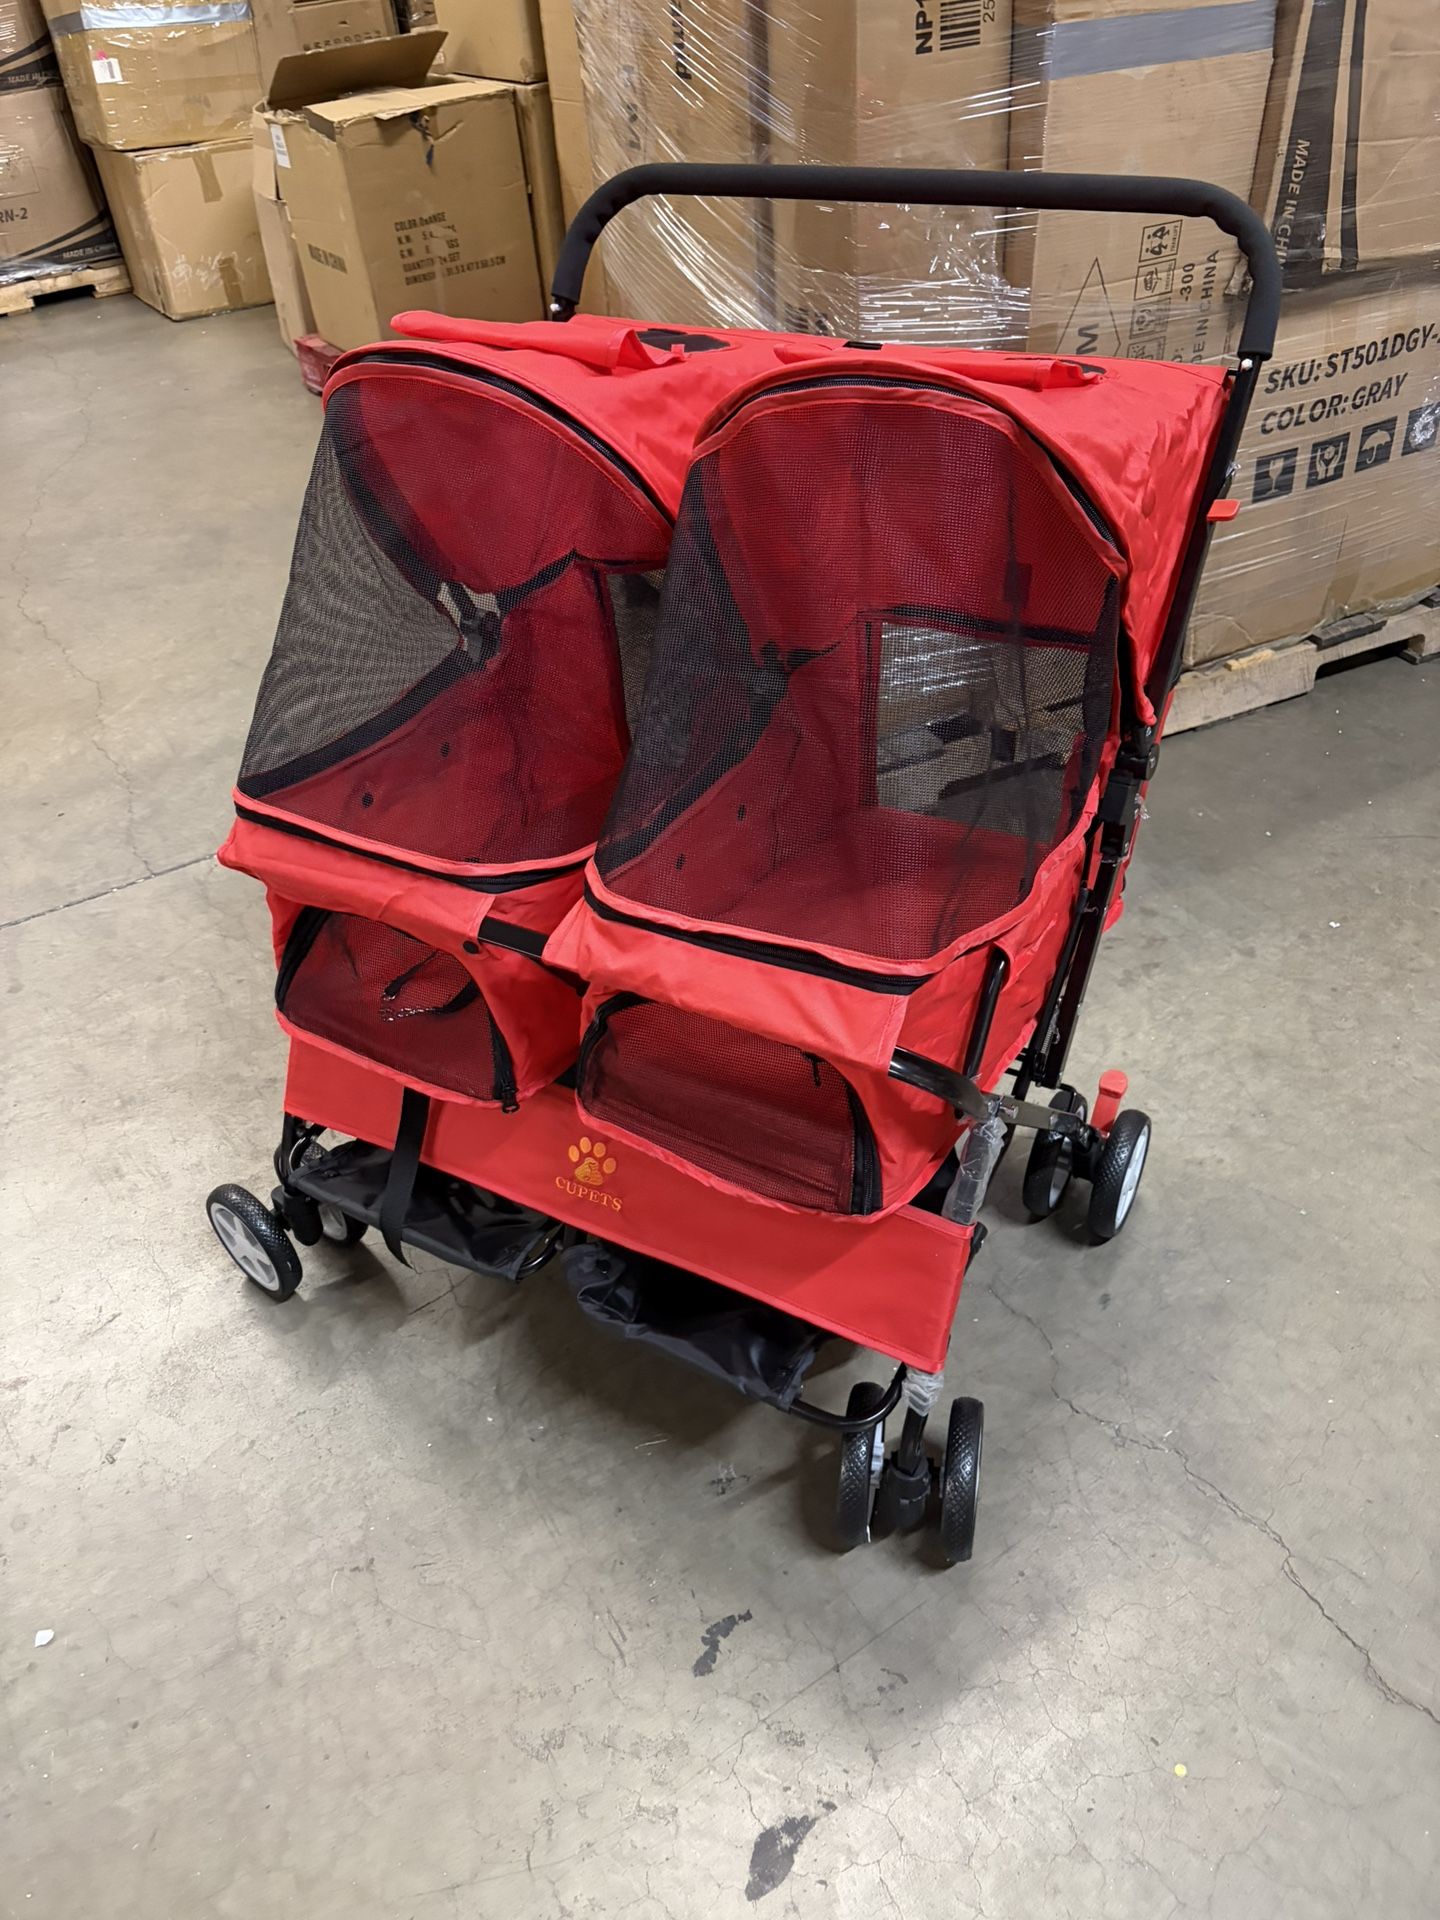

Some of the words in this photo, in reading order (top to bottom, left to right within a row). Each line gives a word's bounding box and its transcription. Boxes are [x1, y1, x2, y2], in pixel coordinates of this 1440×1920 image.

[916, 0, 933, 55] NP
[1288, 139, 1311, 195] MADE
[1281, 199, 1298, 220] IN
[1274, 223, 1292, 270] CHI
[1200, 249, 1220, 313] CHINA
[1195, 318, 1209, 337] IN
[1264, 323, 1440, 394] SKU:ST501DGY-
[555, 1176, 623, 1212] CUPETS
